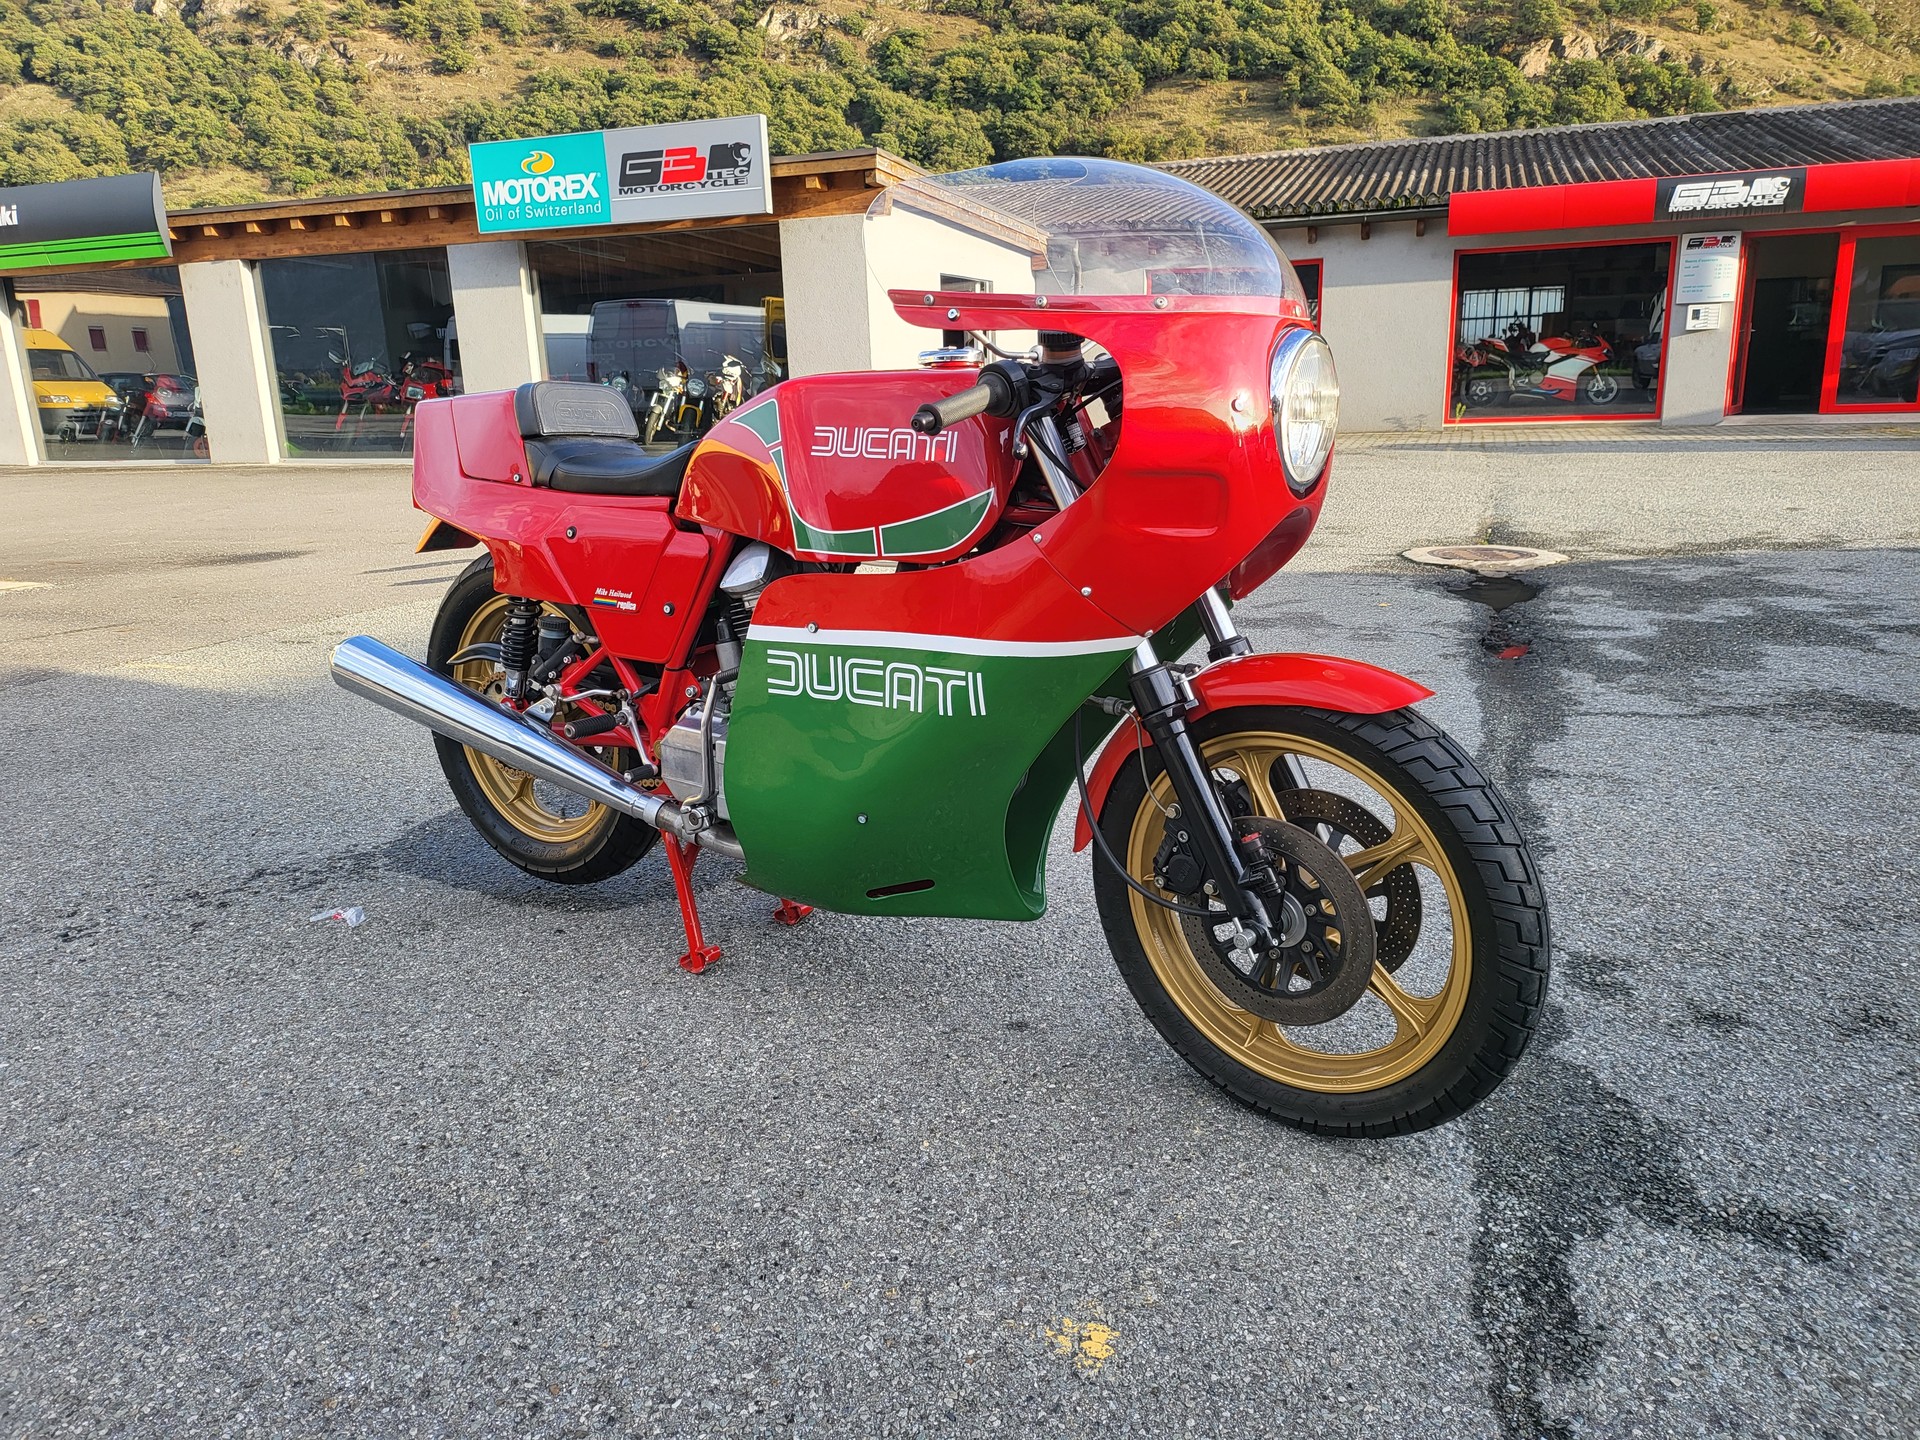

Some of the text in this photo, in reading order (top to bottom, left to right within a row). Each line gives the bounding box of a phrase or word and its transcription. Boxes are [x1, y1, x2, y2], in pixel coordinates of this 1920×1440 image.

[482, 172, 600, 207] MOTOREX
[618, 178, 747, 195] MOTORCYCLE
[0, 204, 19, 226] ki
[485, 200, 602, 221] Oil of Switzerland
[1668, 199, 1784, 213] MOTORCYCLE
[810, 426, 958, 463] DUCATI
[616, 601, 637, 610] replica
[767, 649, 986, 716] DUCATI
